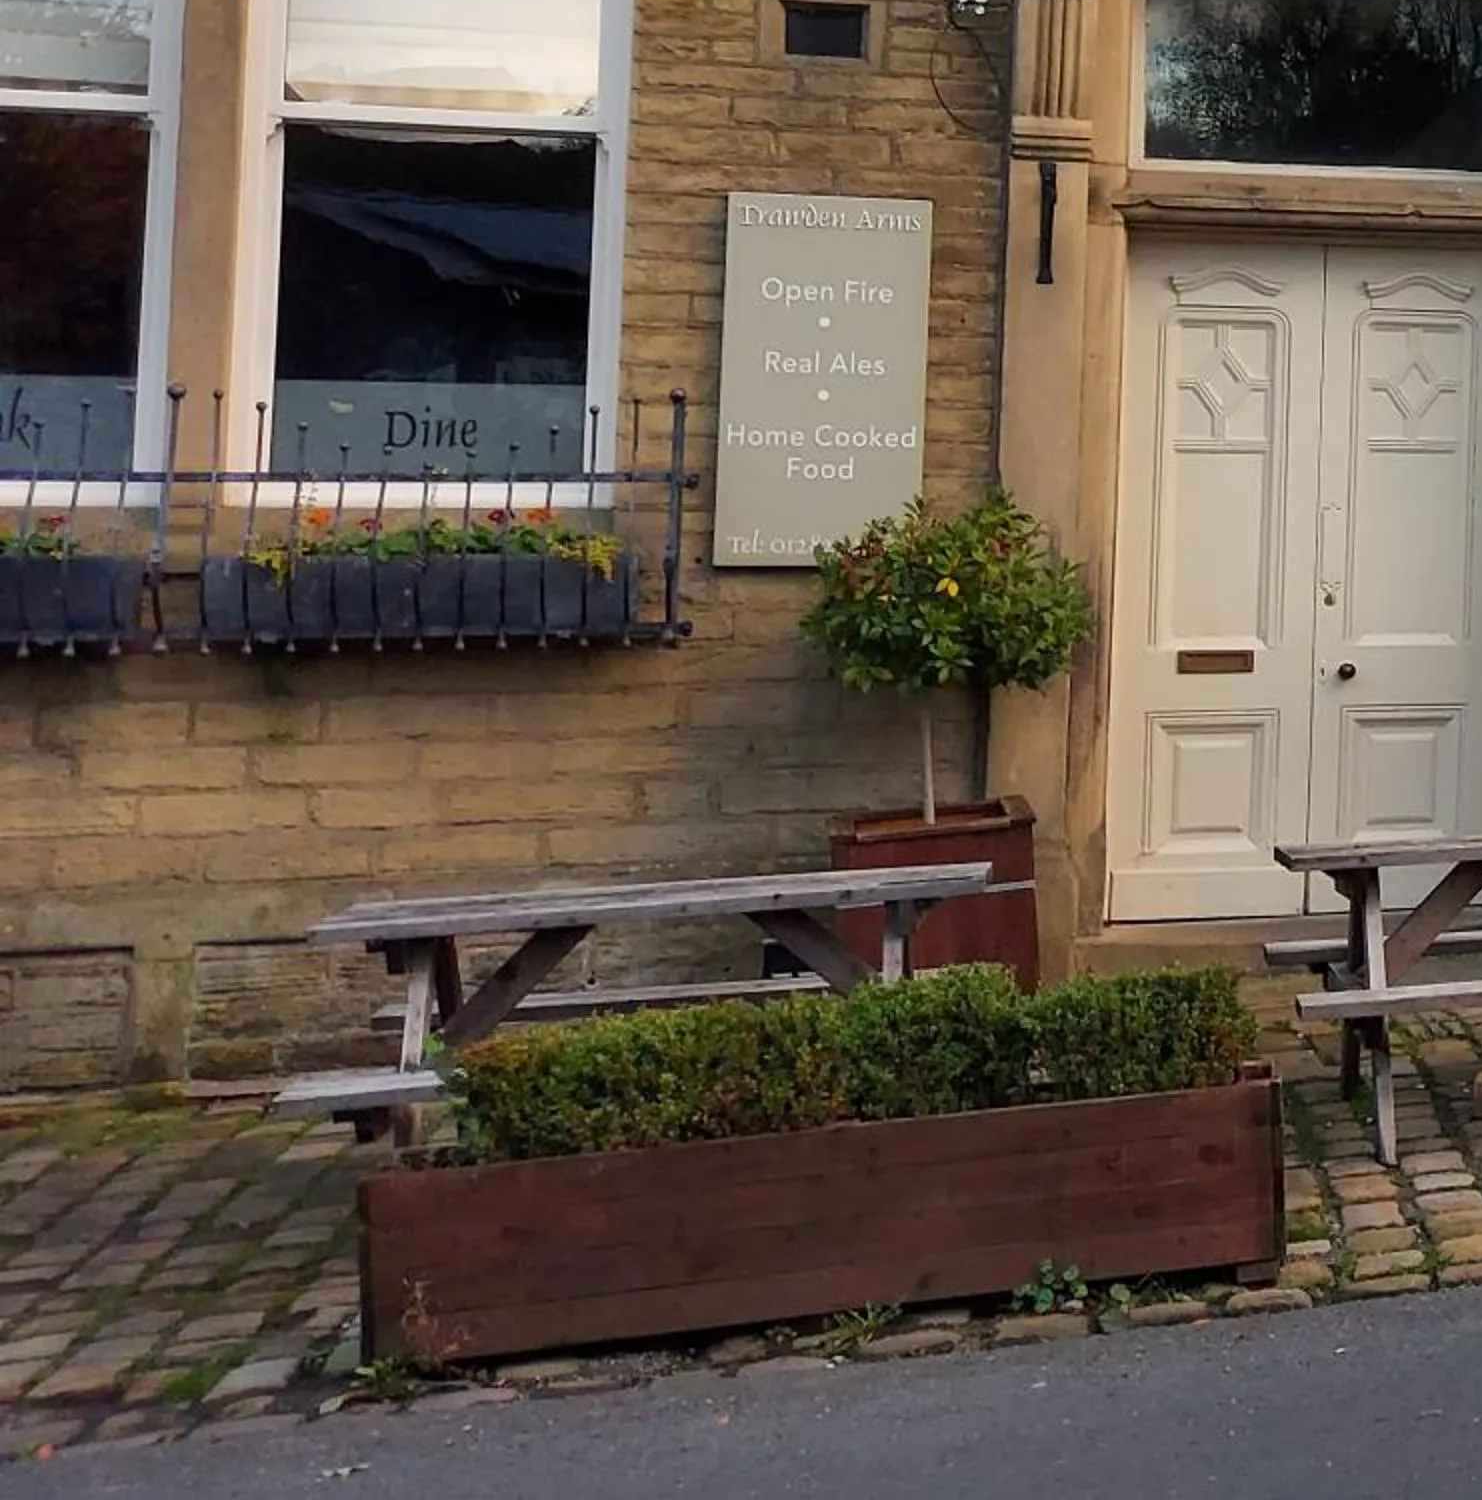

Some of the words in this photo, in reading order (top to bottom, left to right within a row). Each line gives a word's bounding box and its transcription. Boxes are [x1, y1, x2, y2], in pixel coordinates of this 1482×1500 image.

[738, 203, 848, 229] Trawden
[854, 208, 922, 231] Arms
[761, 276, 835, 308] Open
[844, 279, 895, 304] Fire
[764, 351, 821, 375] Real
[829, 352, 886, 376] Ales
[384, 406, 479, 448] Dine
[726, 423, 806, 448] Home
[814, 424, 918, 449] Cooked
[786, 457, 856, 481] Food
